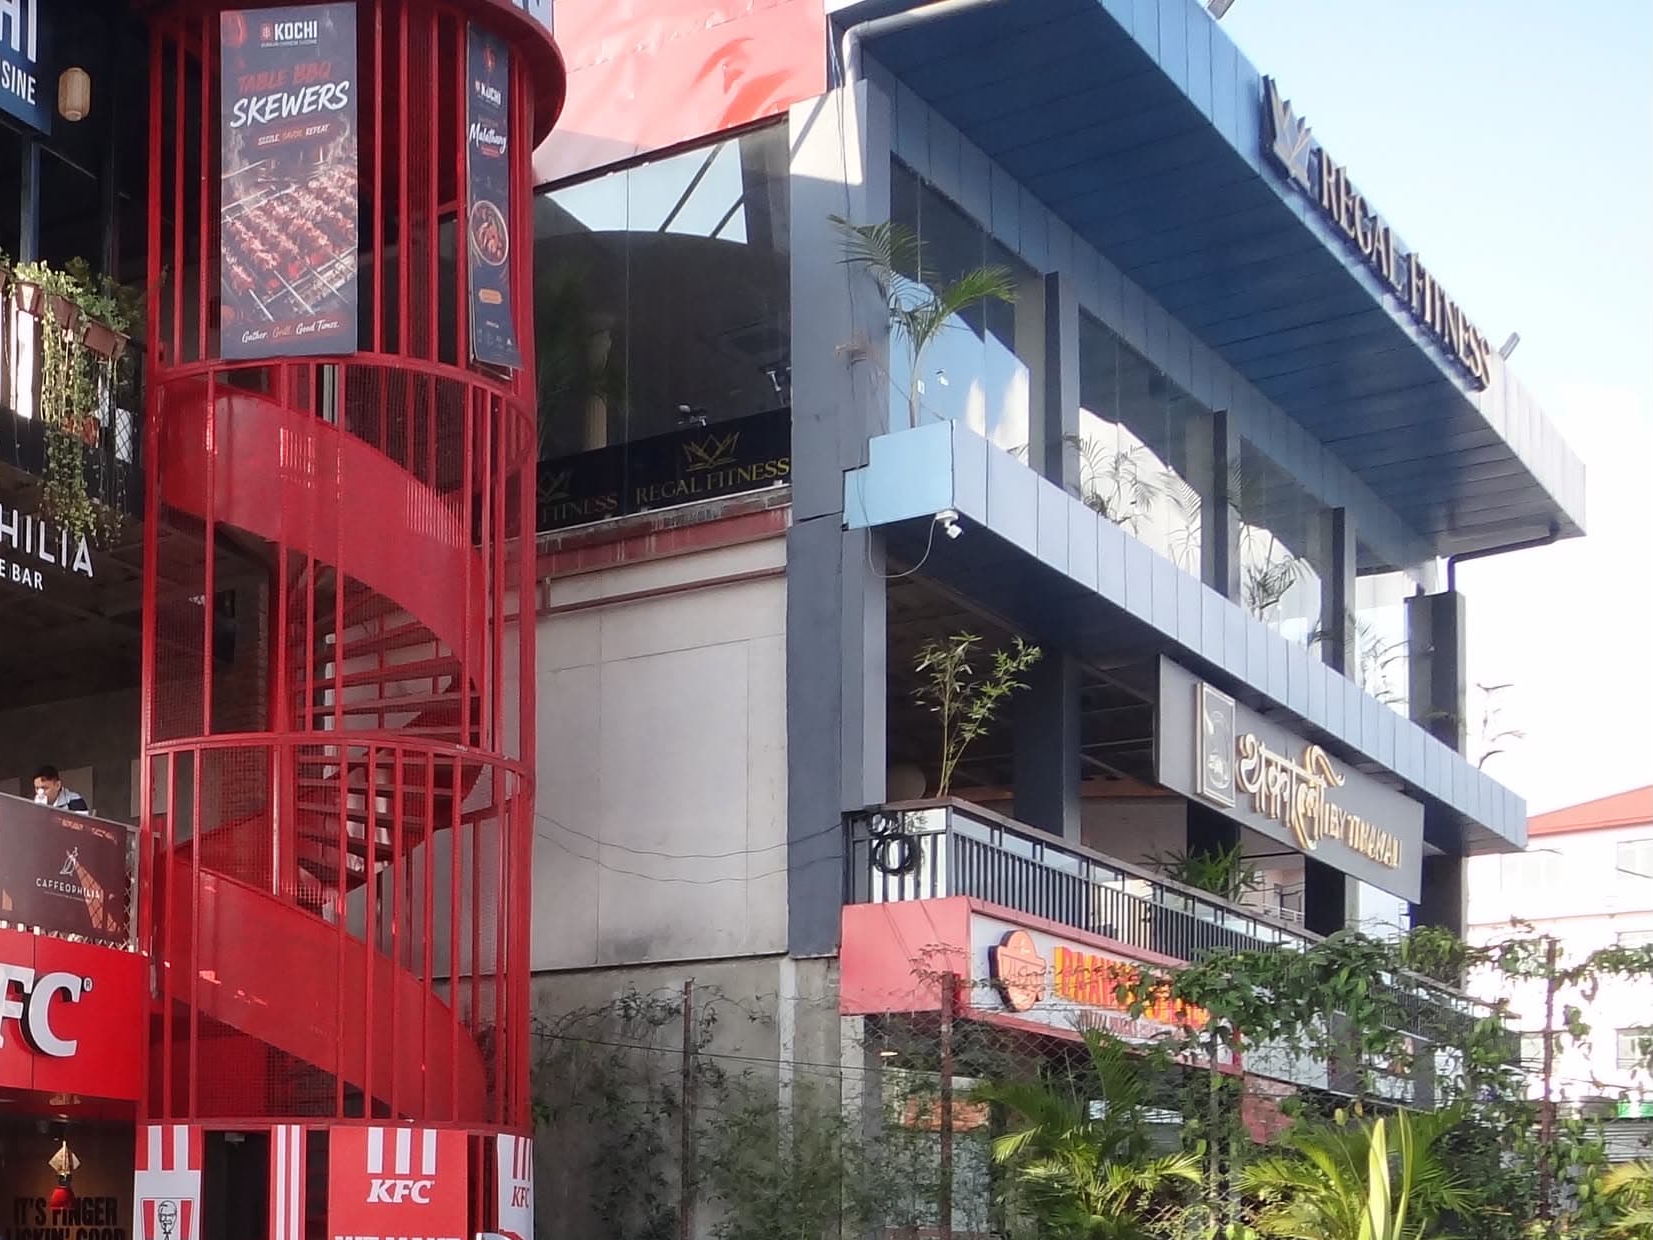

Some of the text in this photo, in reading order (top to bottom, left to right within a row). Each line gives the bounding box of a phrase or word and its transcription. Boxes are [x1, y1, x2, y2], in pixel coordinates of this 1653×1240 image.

[275, 20, 318, 41] KOCHI
[230, 80, 350, 129] SKEWERS
[1320, 147, 1491, 390] REGAL FITNESS
[636, 457, 790, 505] REGAL FITNESS
[11, 558, 44, 591] BAR
[35, 877, 101, 899] CAFFEOPHILIA
[366, 1178, 433, 1204] KFC
[511, 1185, 530, 1209] KFC
[14, 1196, 46, 1226] IT'S
